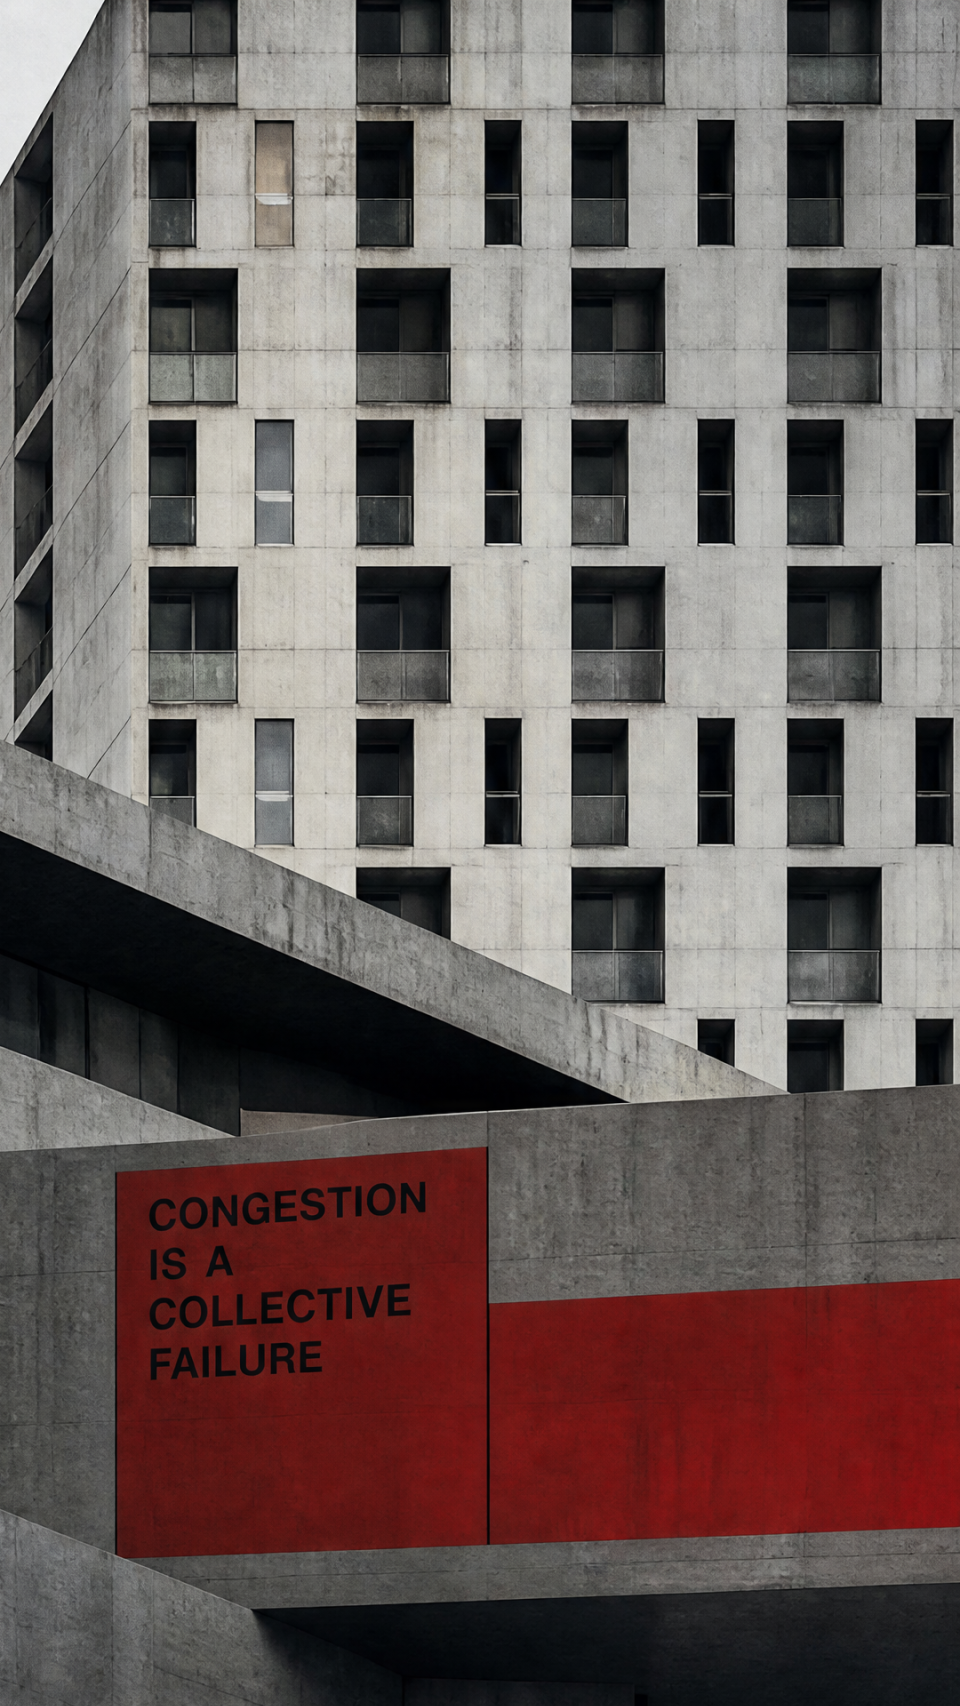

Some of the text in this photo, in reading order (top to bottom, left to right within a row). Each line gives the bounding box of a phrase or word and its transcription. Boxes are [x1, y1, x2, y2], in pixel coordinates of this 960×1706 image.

[148, 1181, 427, 1232] CONGESTION
[149, 1245, 234, 1281] IS A
[148, 1283, 412, 1331] COLLECTIVE
[149, 1340, 323, 1381] FAILURE
